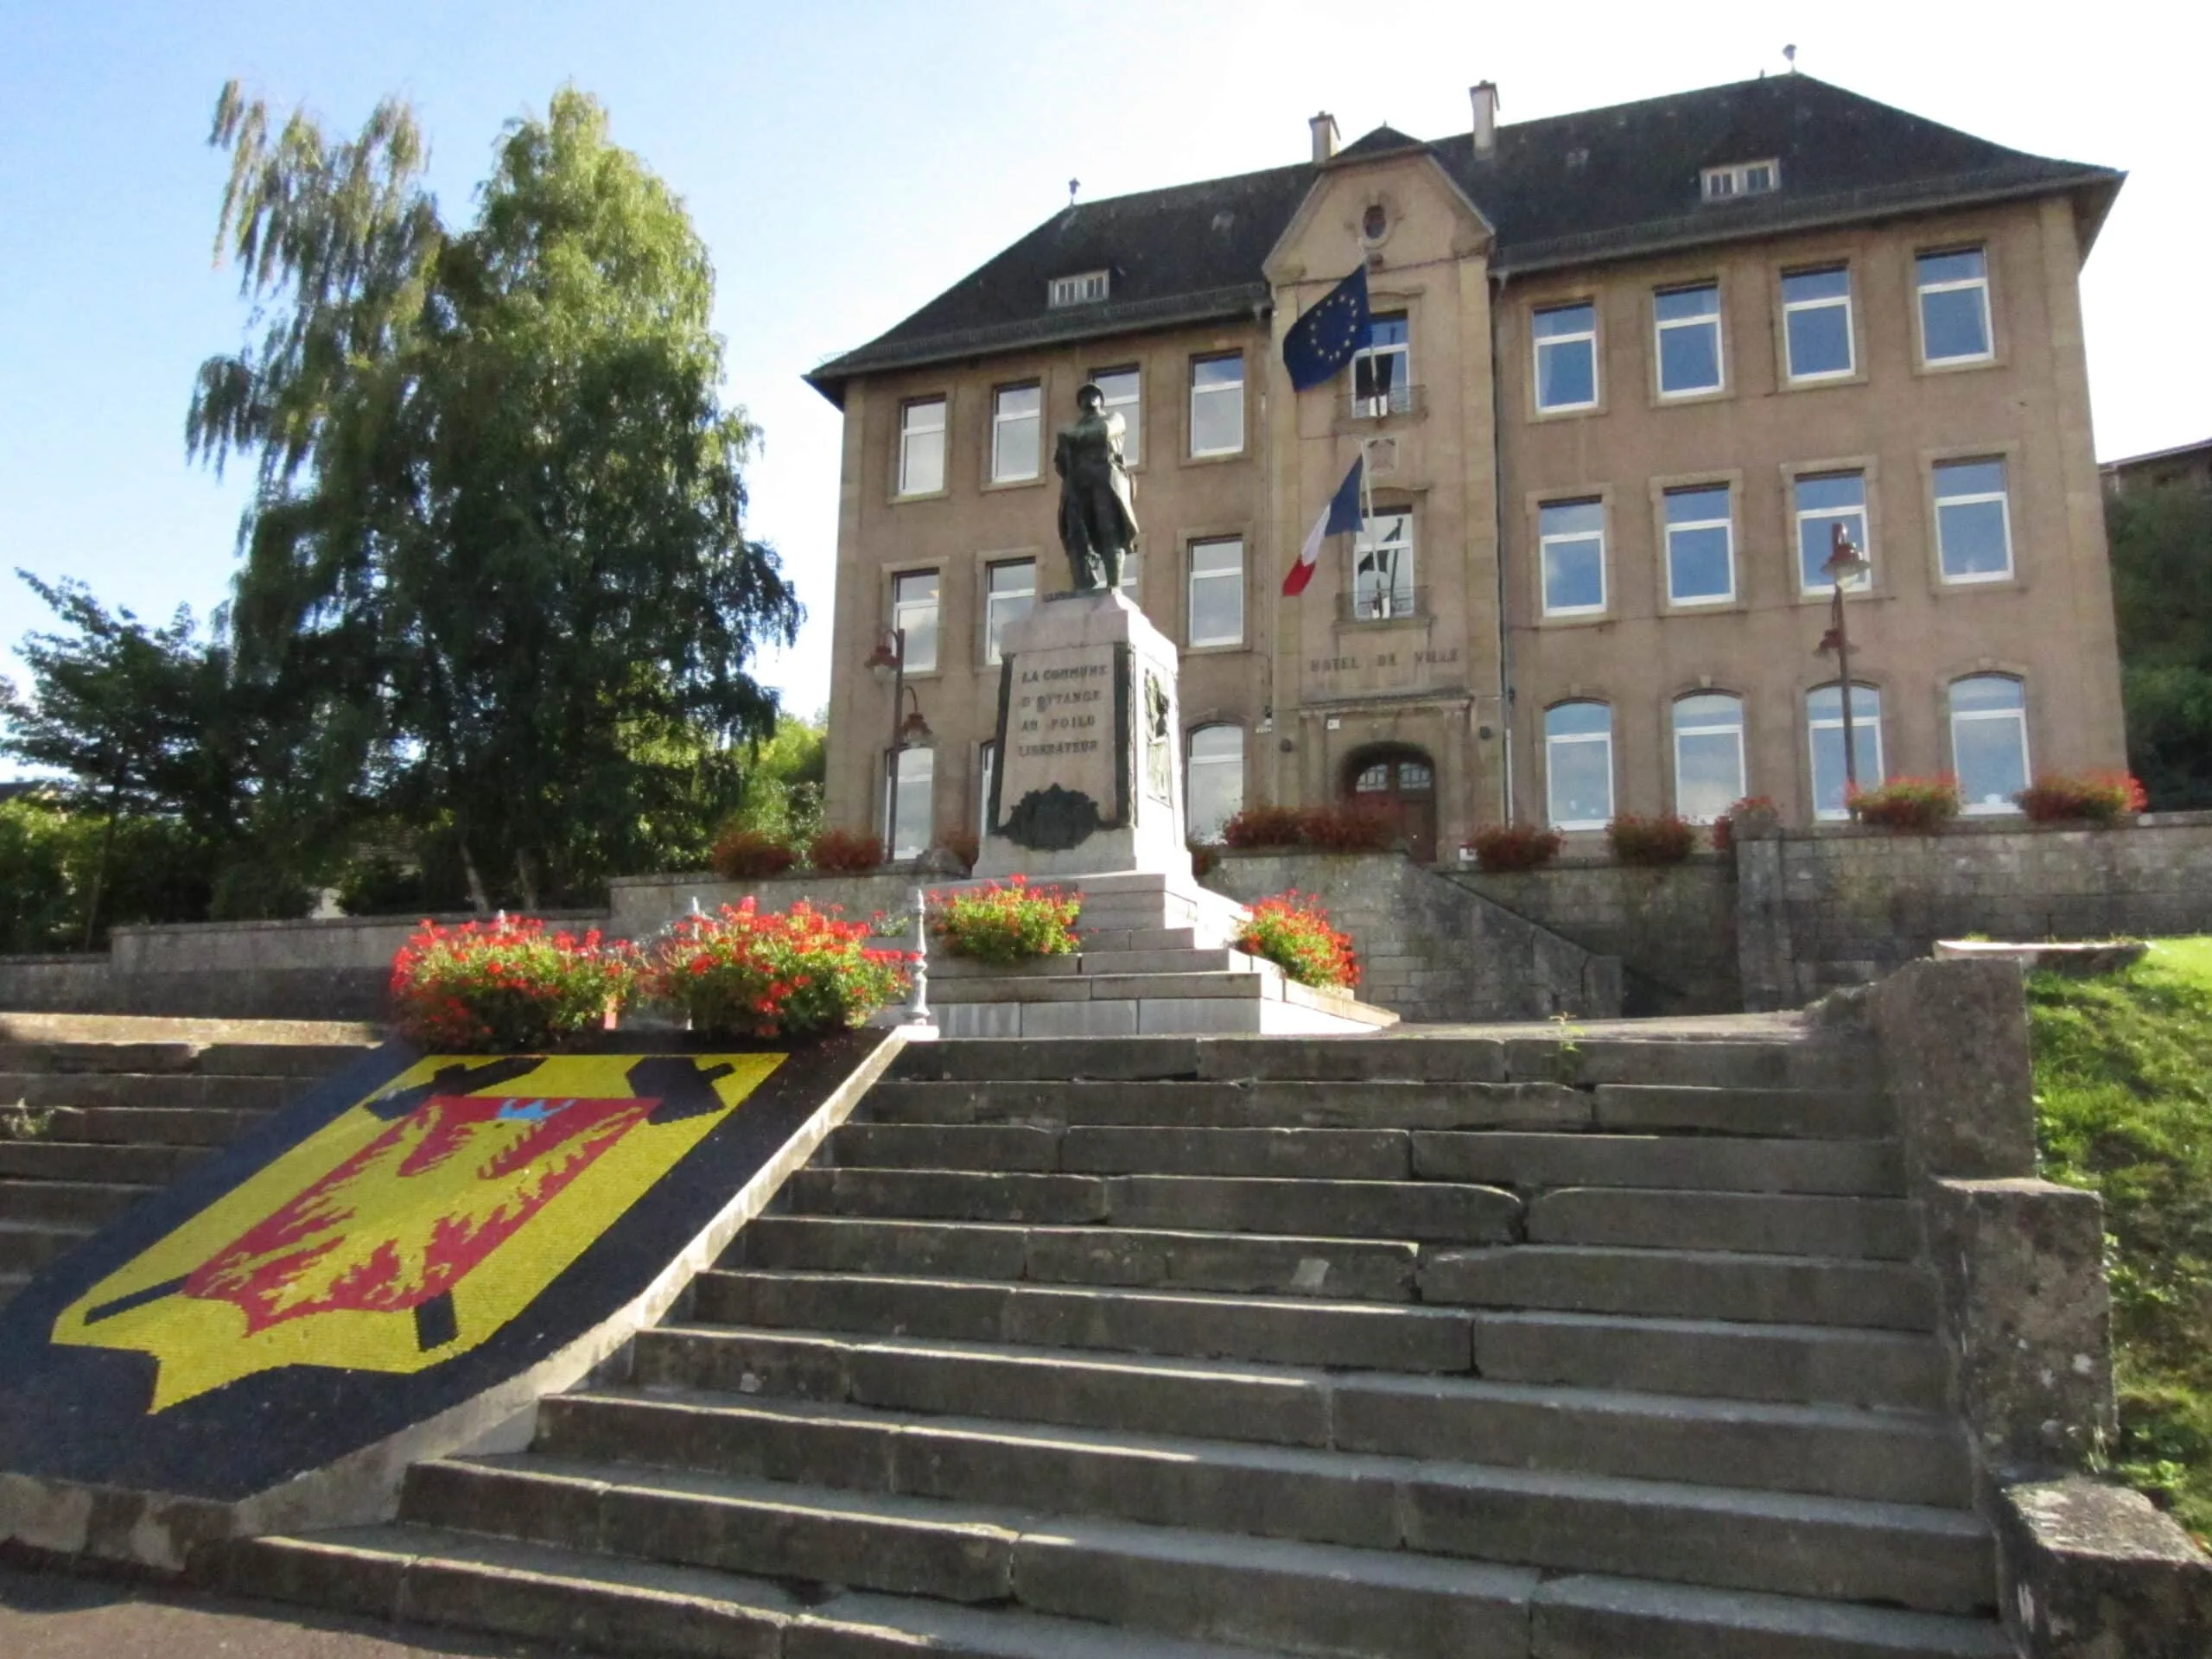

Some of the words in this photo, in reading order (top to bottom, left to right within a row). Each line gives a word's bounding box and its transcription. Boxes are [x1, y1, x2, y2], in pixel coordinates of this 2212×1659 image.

[1377, 652, 1396, 666] DE
[1414, 647, 1459, 664] VILLE
[1021, 671, 1039, 684] LA
[1043, 664, 1107, 681] COMMUNE
[1020, 718, 1039, 732] AU
[1050, 714, 1096, 730] POILU
